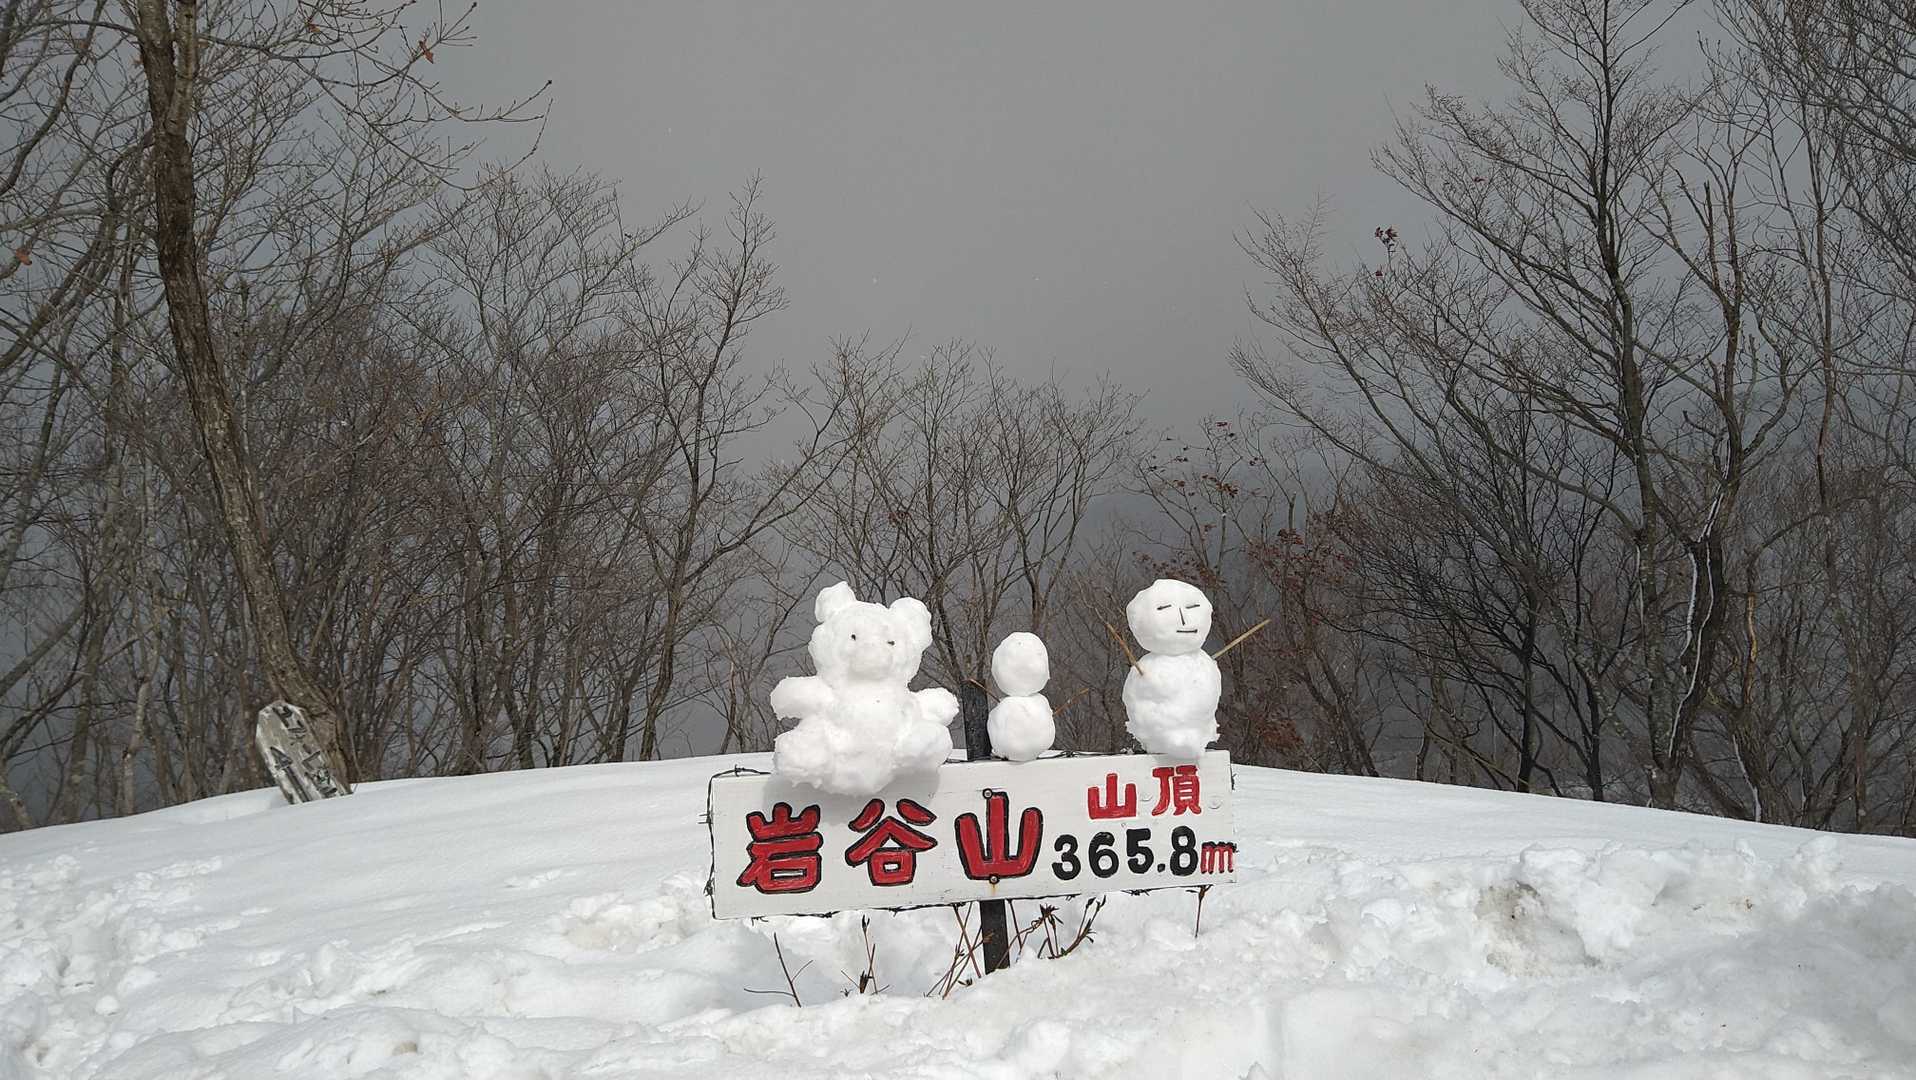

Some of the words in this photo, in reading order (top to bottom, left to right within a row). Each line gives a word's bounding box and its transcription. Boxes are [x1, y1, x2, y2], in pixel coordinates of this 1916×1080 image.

[1088, 765, 1201, 819] 山頂
[737, 791, 1043, 894] 岩谷山
[1052, 826, 1234, 880] 365.8m
